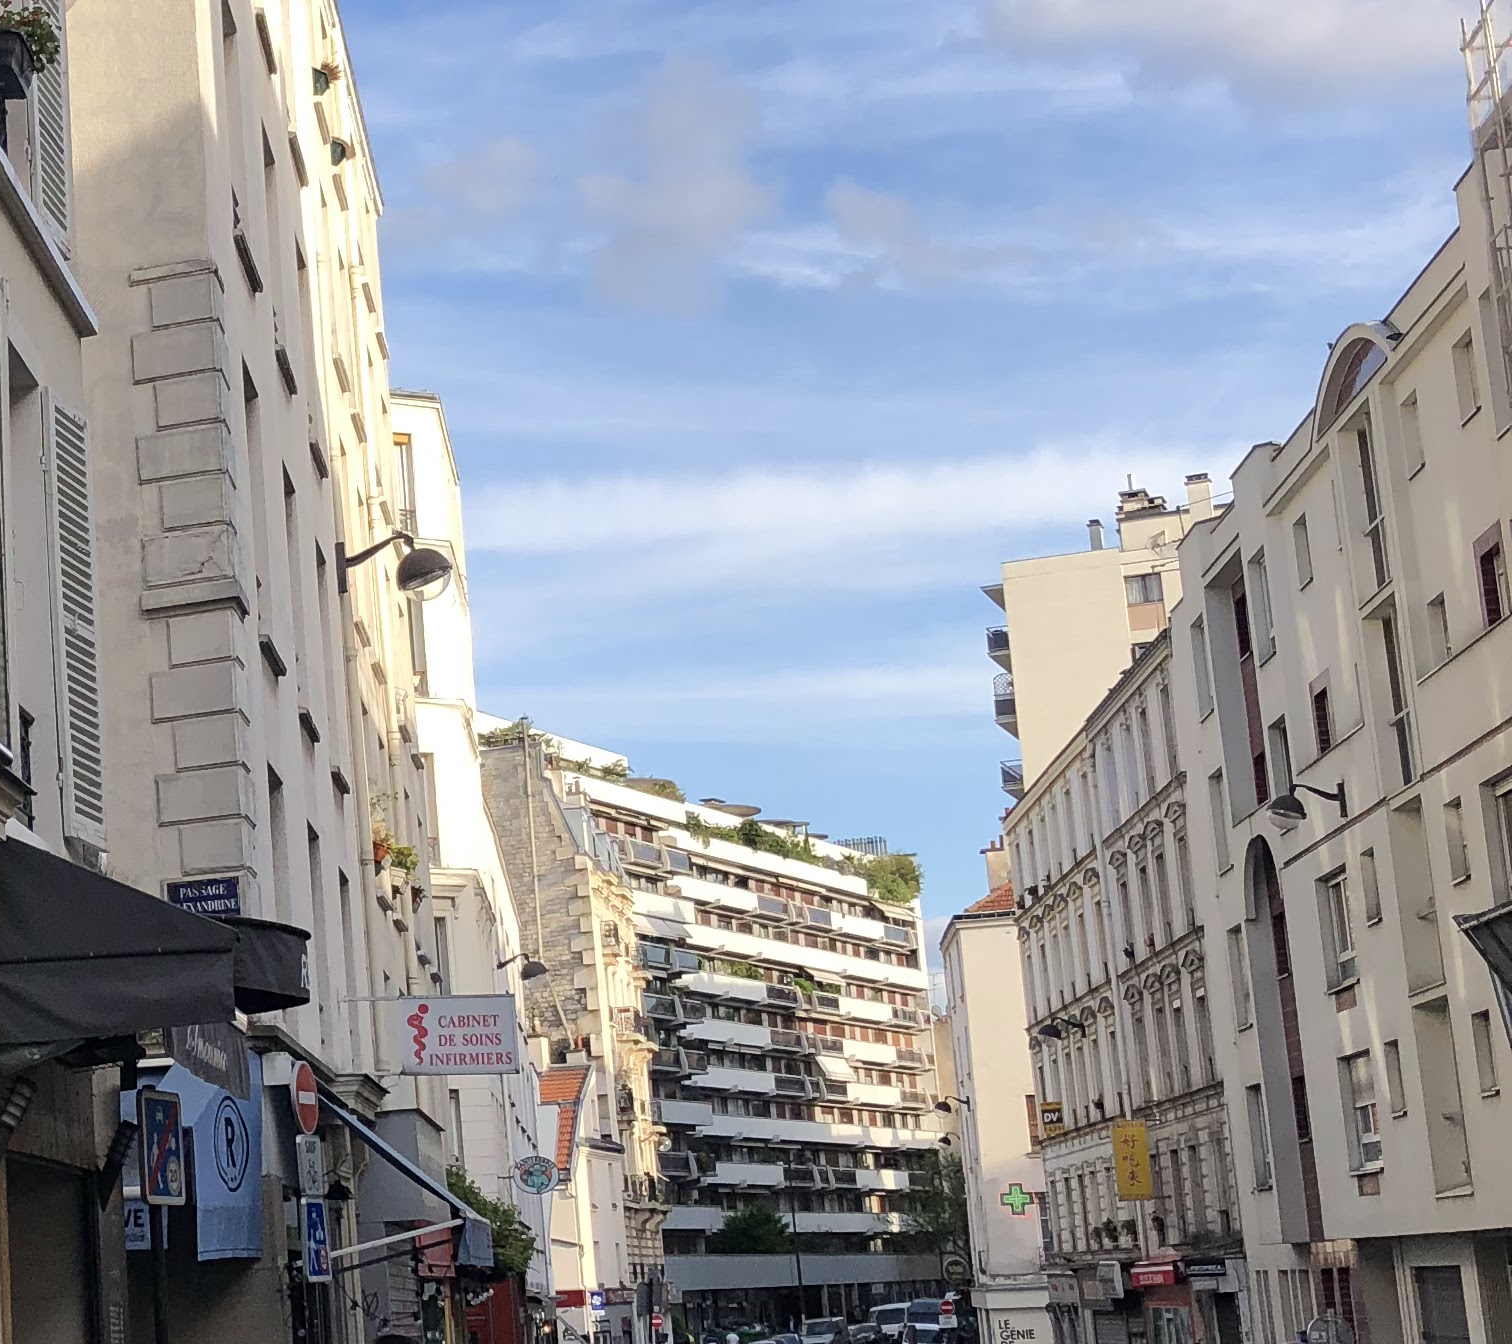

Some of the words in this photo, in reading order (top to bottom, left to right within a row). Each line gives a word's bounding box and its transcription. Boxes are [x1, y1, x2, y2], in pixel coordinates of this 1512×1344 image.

[437, 1013, 500, 1029] CABINET
[437, 1034, 457, 1047] DE
[461, 1032, 502, 1047] SOINS
[428, 1051, 513, 1067] INFIRMIERS
[1043, 1111, 1059, 1123] DV
[224, 1116, 237, 1169] R
[168, 1167, 178, 1183] 20
[998, 1319, 1011, 1330] LE
